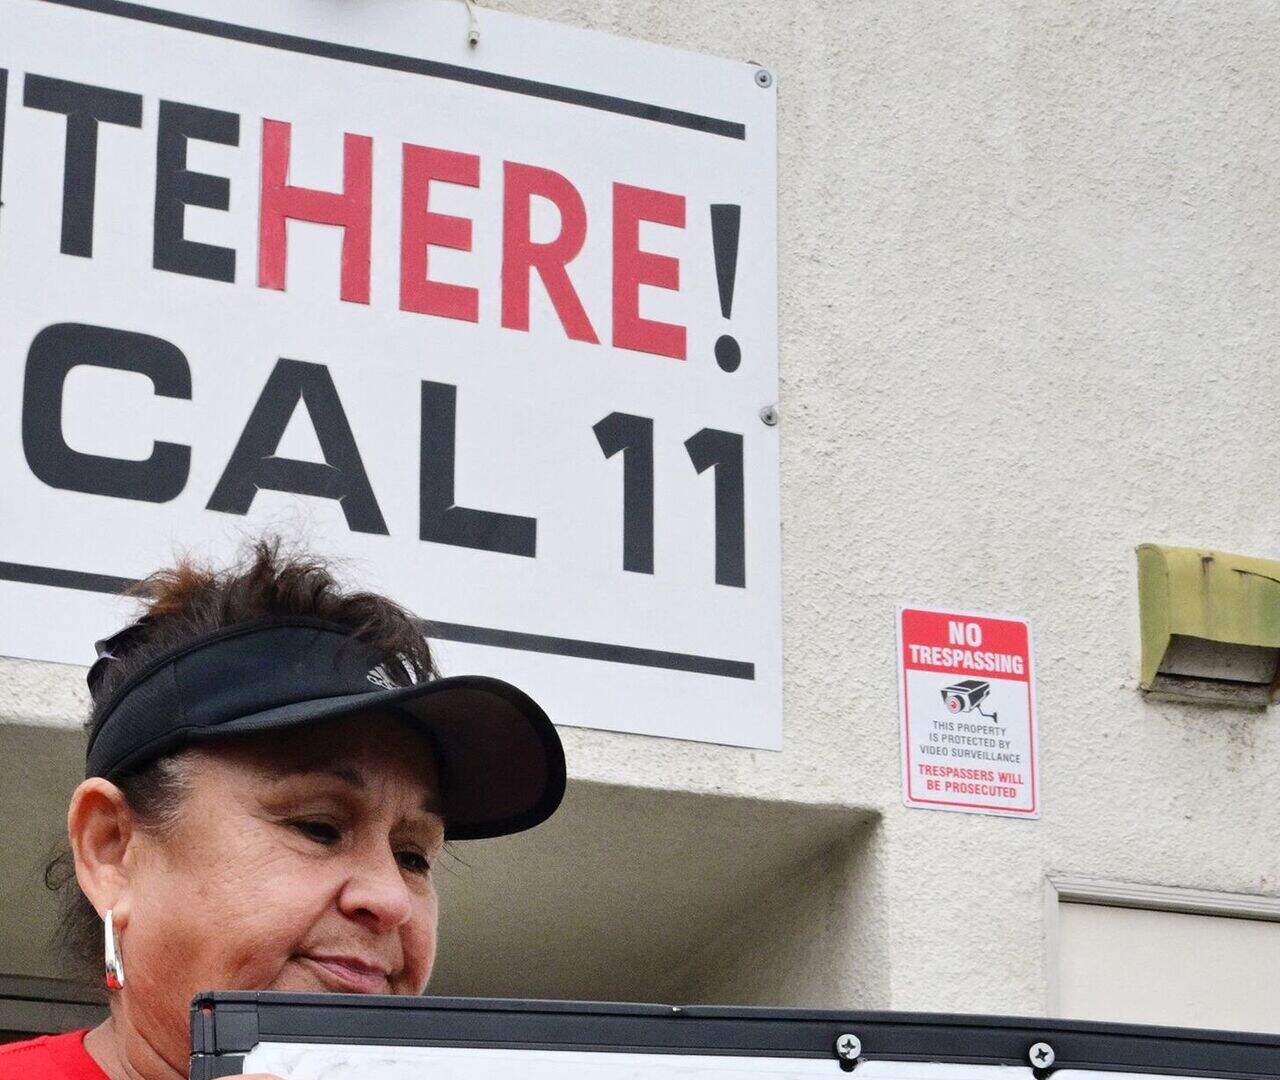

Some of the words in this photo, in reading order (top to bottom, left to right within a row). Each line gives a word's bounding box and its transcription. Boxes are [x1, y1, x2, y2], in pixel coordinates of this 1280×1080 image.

[591, 411, 746, 589] 11
[948, 620, 983, 647] NO
[908, 644, 1024, 675] TRESPASSING
[933, 720, 955, 732] THIS
[957, 723, 1007, 736] PROPERTY
[929, 732, 939, 743] IS
[941, 734, 996, 748] PROTECTED
[999, 740, 1011, 749] BY
[919, 745, 949, 757] VIDEO
[951, 747, 1021, 764] SURVEILLANCE
[918, 764, 995, 782] TRESPASSERS
[998, 771, 1024, 785] WILL
[926, 779, 941, 791] BE
[945, 781, 1017, 798] PROSECUTED
